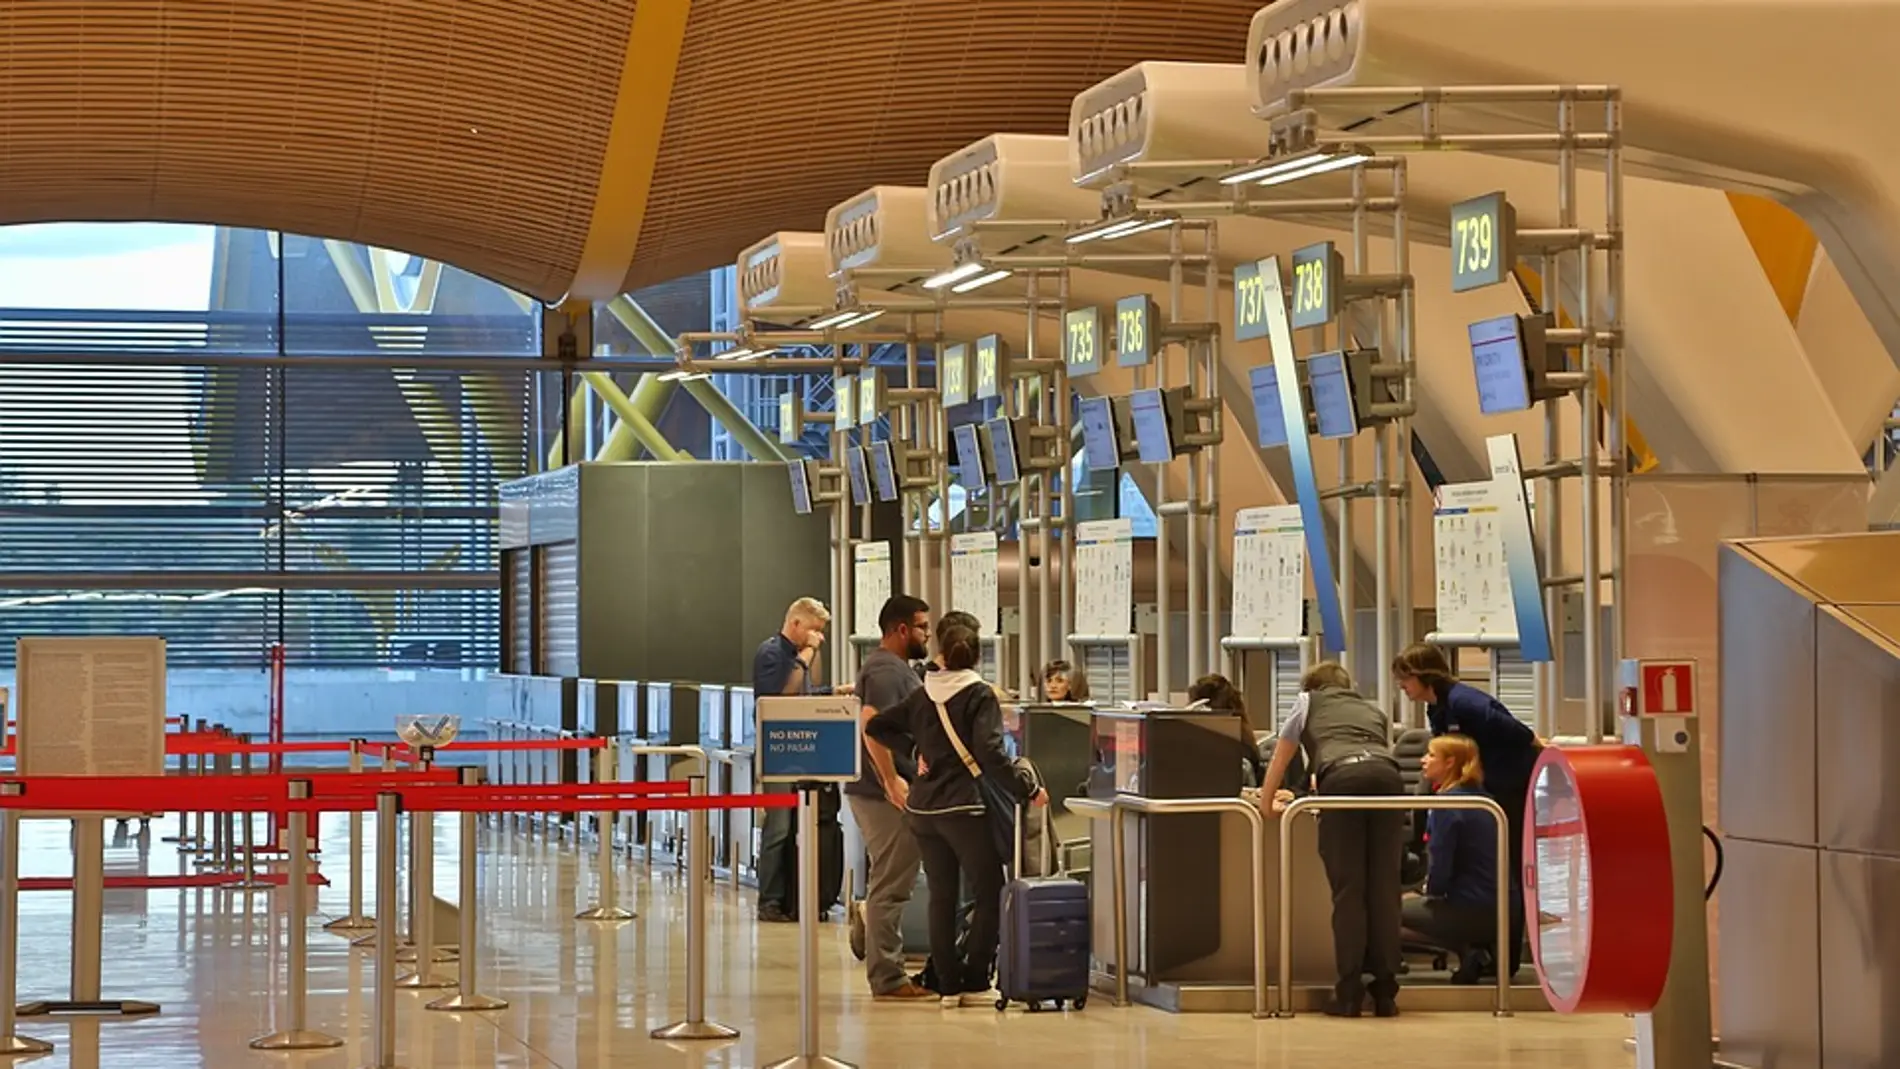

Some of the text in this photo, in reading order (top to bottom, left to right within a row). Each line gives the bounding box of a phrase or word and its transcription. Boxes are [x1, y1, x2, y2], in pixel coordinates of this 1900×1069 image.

[1455, 213, 1492, 275] 739
[1237, 277, 1265, 327] 737
[1295, 259, 1324, 313] 738
[1070, 320, 1093, 364] 735
[1120, 309, 1143, 354] 736
[770, 731, 818, 740] NO ENTRY
[770, 744, 816, 753] NO PASAR
